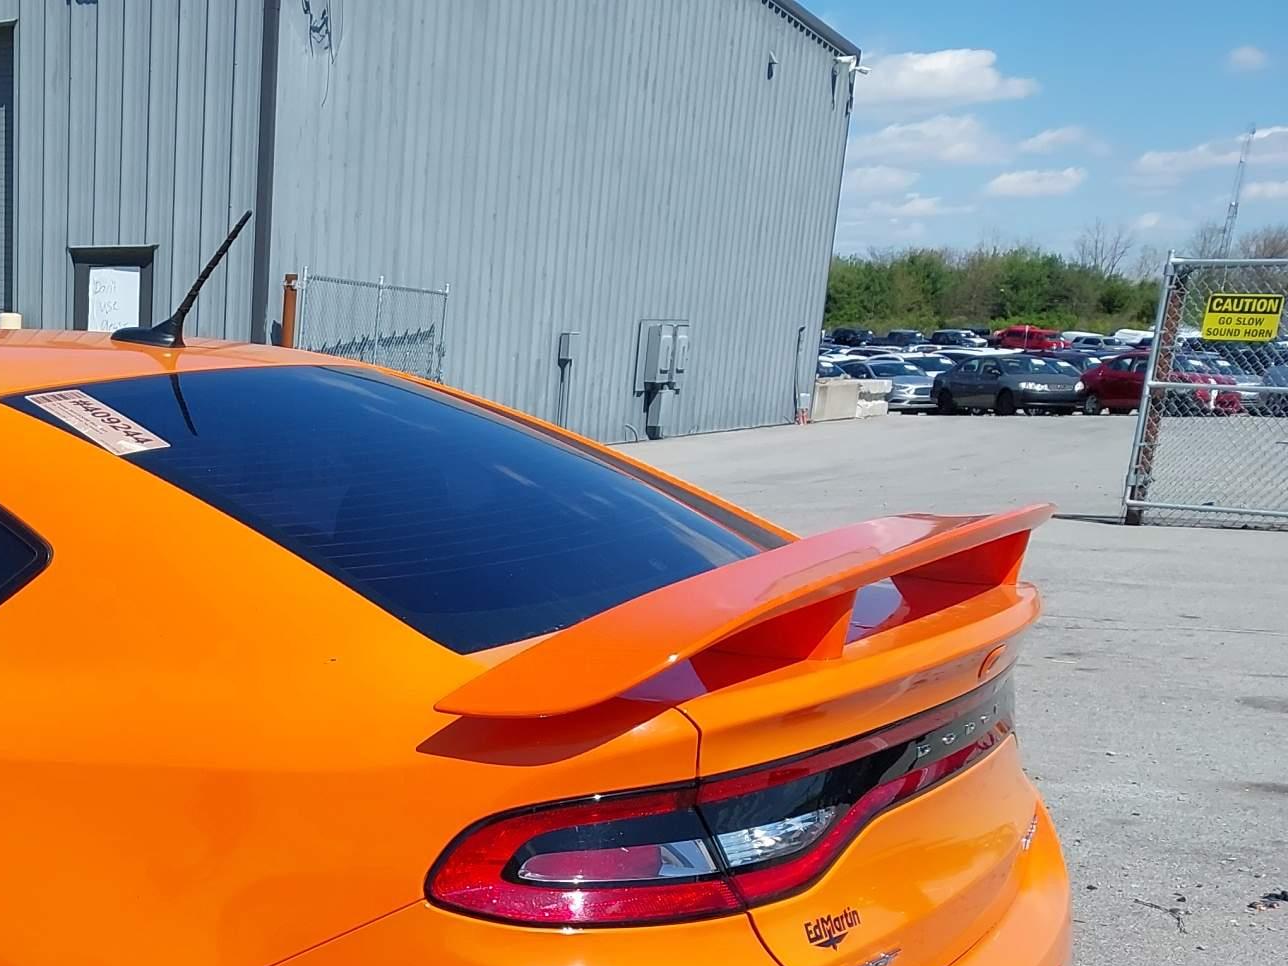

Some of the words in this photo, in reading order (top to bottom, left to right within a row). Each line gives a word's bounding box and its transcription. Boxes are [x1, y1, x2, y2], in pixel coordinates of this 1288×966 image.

[1212, 298, 1279, 313] CAUTION
[1218, 316, 1233, 325] GO
[1235, 317, 1265, 326] SLOW
[1206, 327, 1241, 337] SOUND
[1243, 328, 1273, 338] HORN
[68, 399, 153, 445] #409244
